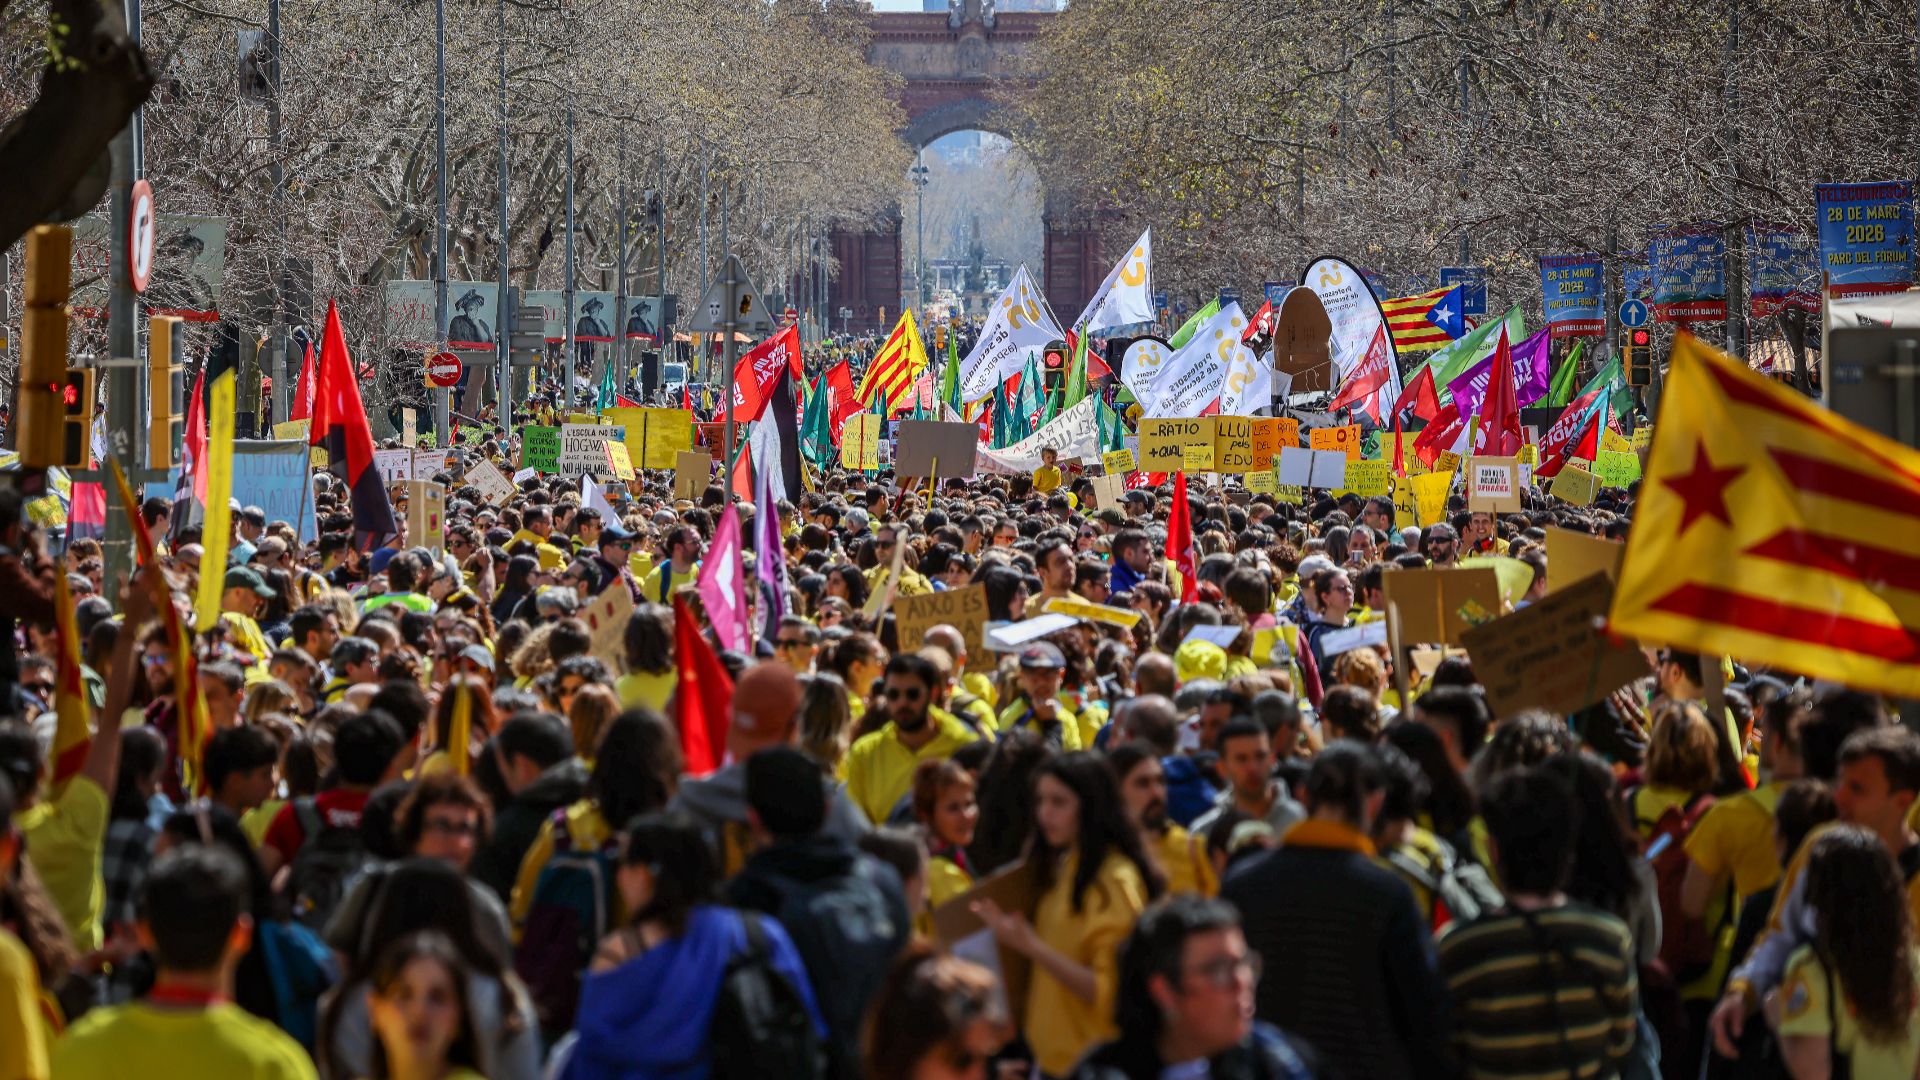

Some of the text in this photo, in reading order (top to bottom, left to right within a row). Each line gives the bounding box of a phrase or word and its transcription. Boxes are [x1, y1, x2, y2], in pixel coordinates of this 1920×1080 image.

[1827, 207, 1843, 222] 28
[1847, 206, 1863, 221] DE
[1846, 224, 1885, 243] 2026
[1827, 252, 1853, 265] PARC
[1855, 251, 1872, 264] DEL
[1547, 271, 1557, 280] 28
[1558, 280, 1585, 294] 2026
[598, 429, 608, 437] NO
[1218, 420, 1251, 438] LLUI
[1253, 424, 1271, 436] LES
[1314, 432, 1331, 444] EL
[565, 438, 606, 453] HOGWA
[1256, 441, 1271, 451] DEL
[1223, 453, 1252, 466] EDU
[562, 462, 573, 474] NO
[574, 462, 582, 473] HI
